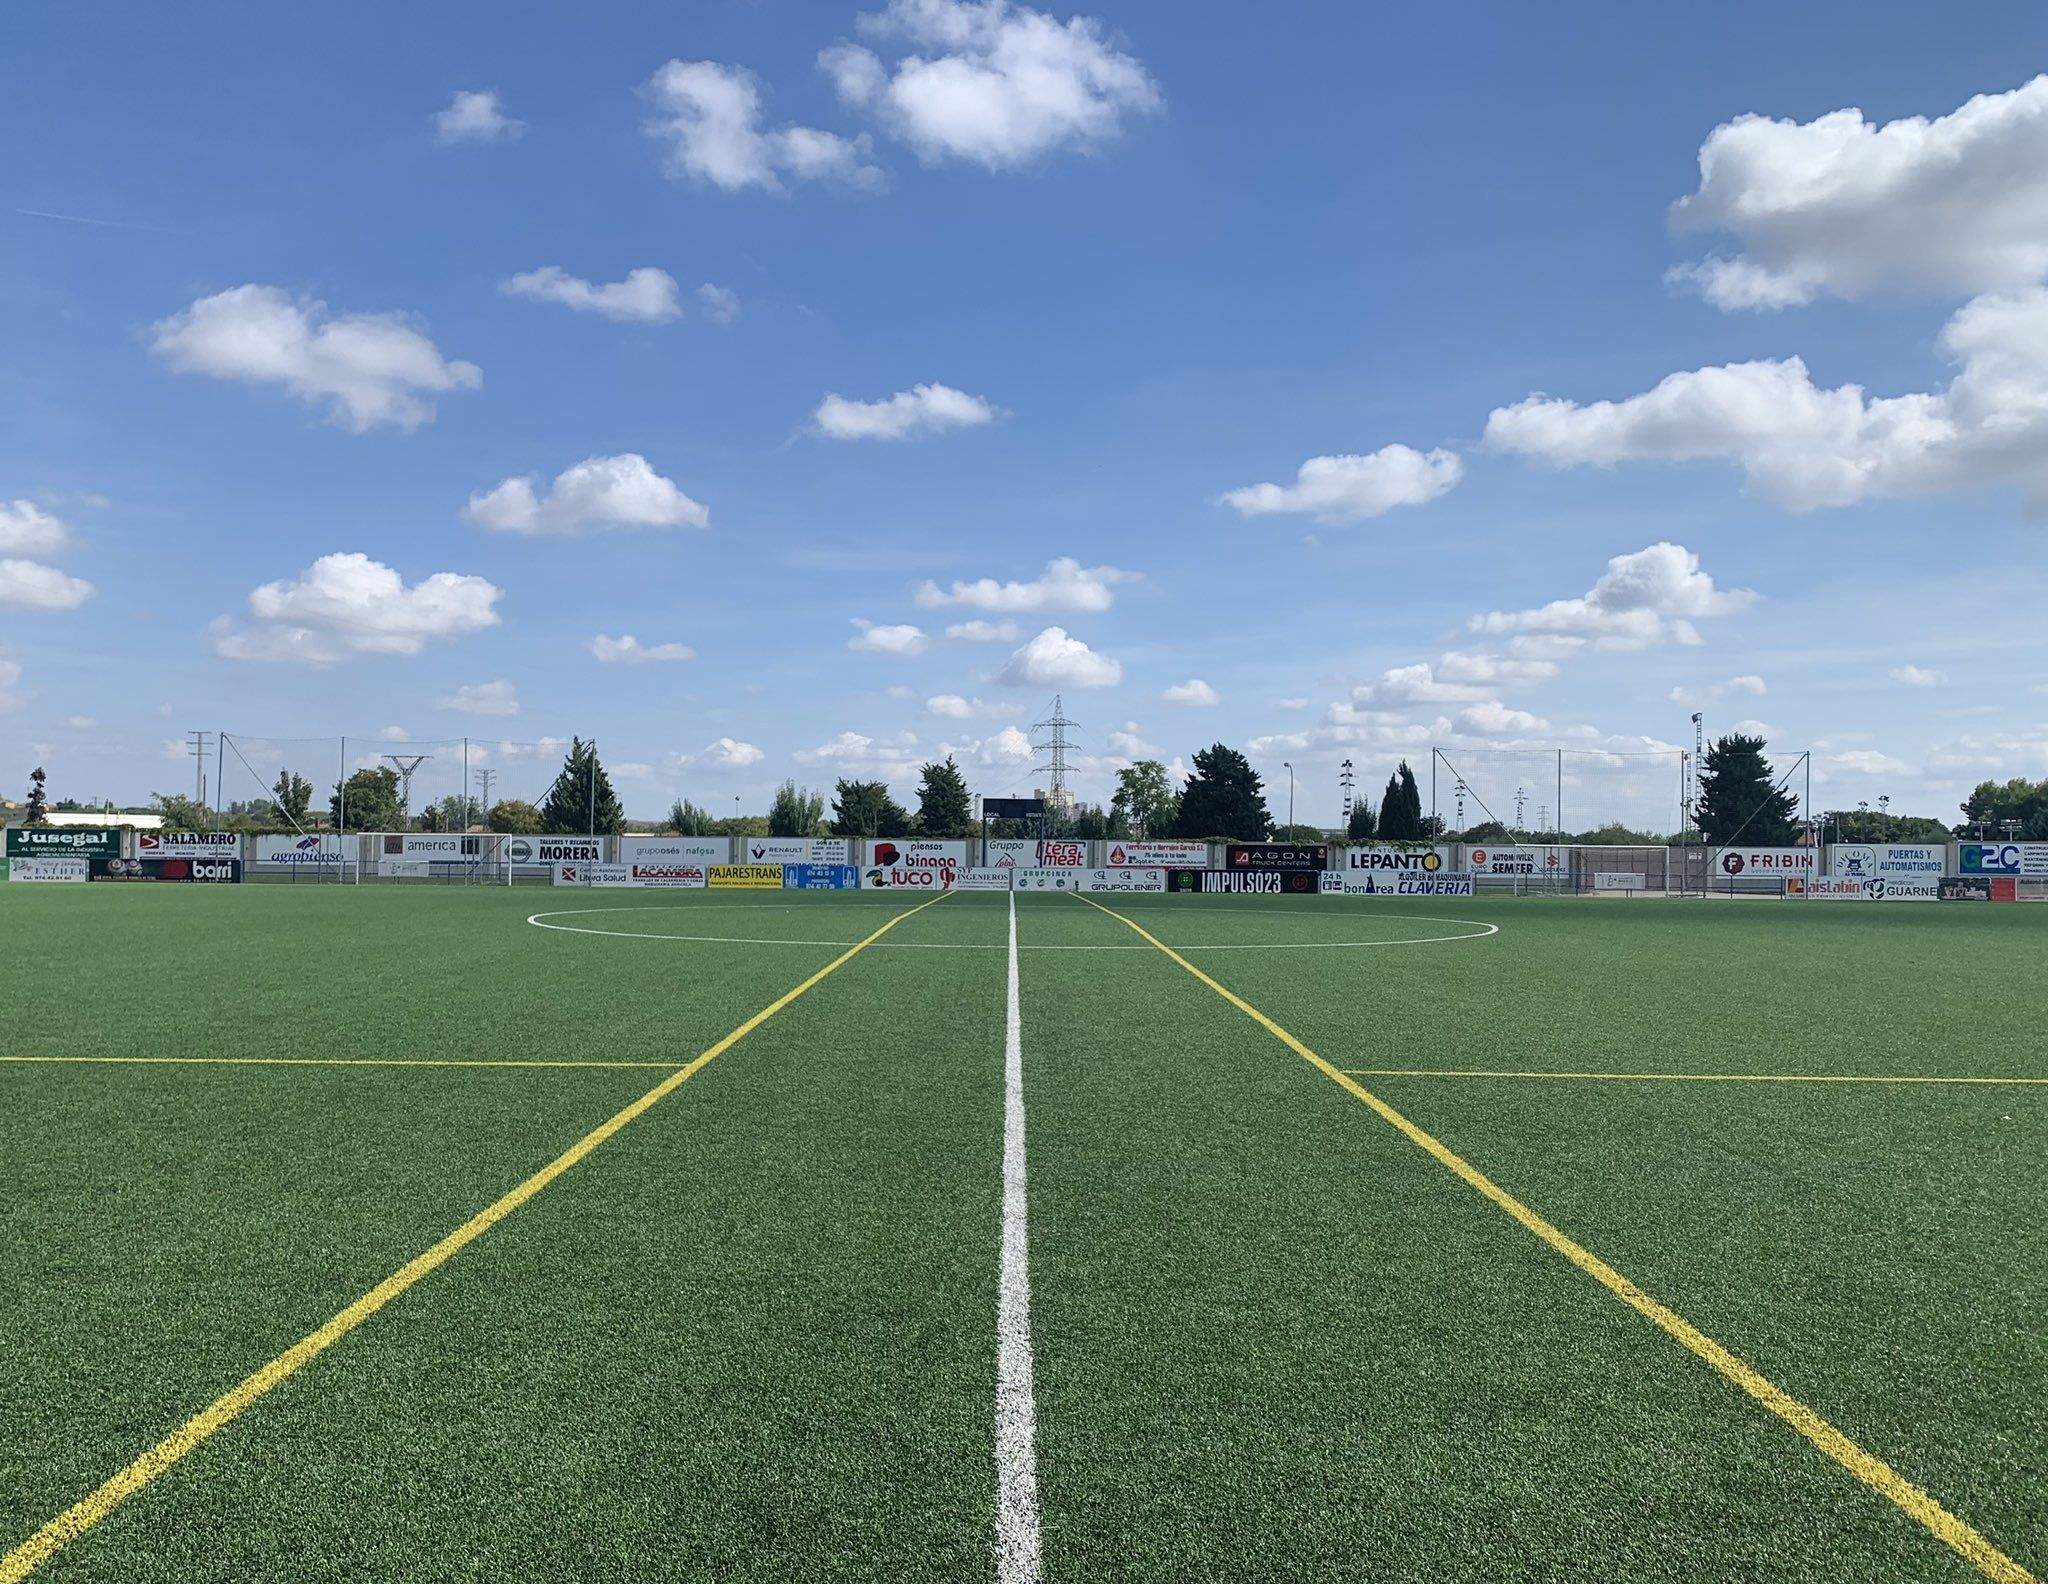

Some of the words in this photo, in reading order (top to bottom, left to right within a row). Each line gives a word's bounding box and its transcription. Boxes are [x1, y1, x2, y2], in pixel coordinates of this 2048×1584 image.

[18, 830, 108, 846] Jusegal
[163, 834, 236, 844] SALAMERO
[408, 840, 456, 850] america
[910, 842, 943, 852] piensos
[990, 841, 1024, 851] Gruppo
[540, 846, 599, 860] MORERA
[1044, 851, 1083, 866] meat
[1888, 850, 1923, 859] PUERTAS
[1927, 850, 1932, 859] Y
[1351, 852, 1442, 872] LEPANTO
[1750, 855, 1812, 868] FRIBIN
[1880, 862, 1942, 871] AUTOMATISMOS
[192, 861, 232, 878] barri
[710, 867, 782, 879] PAJARESTRANS
[603, 874, 626, 882] Salud
[891, 868, 933, 885] tuco
[1398, 882, 1470, 894] CLAVERIA
[1887, 887, 1937, 896] GUARNE
